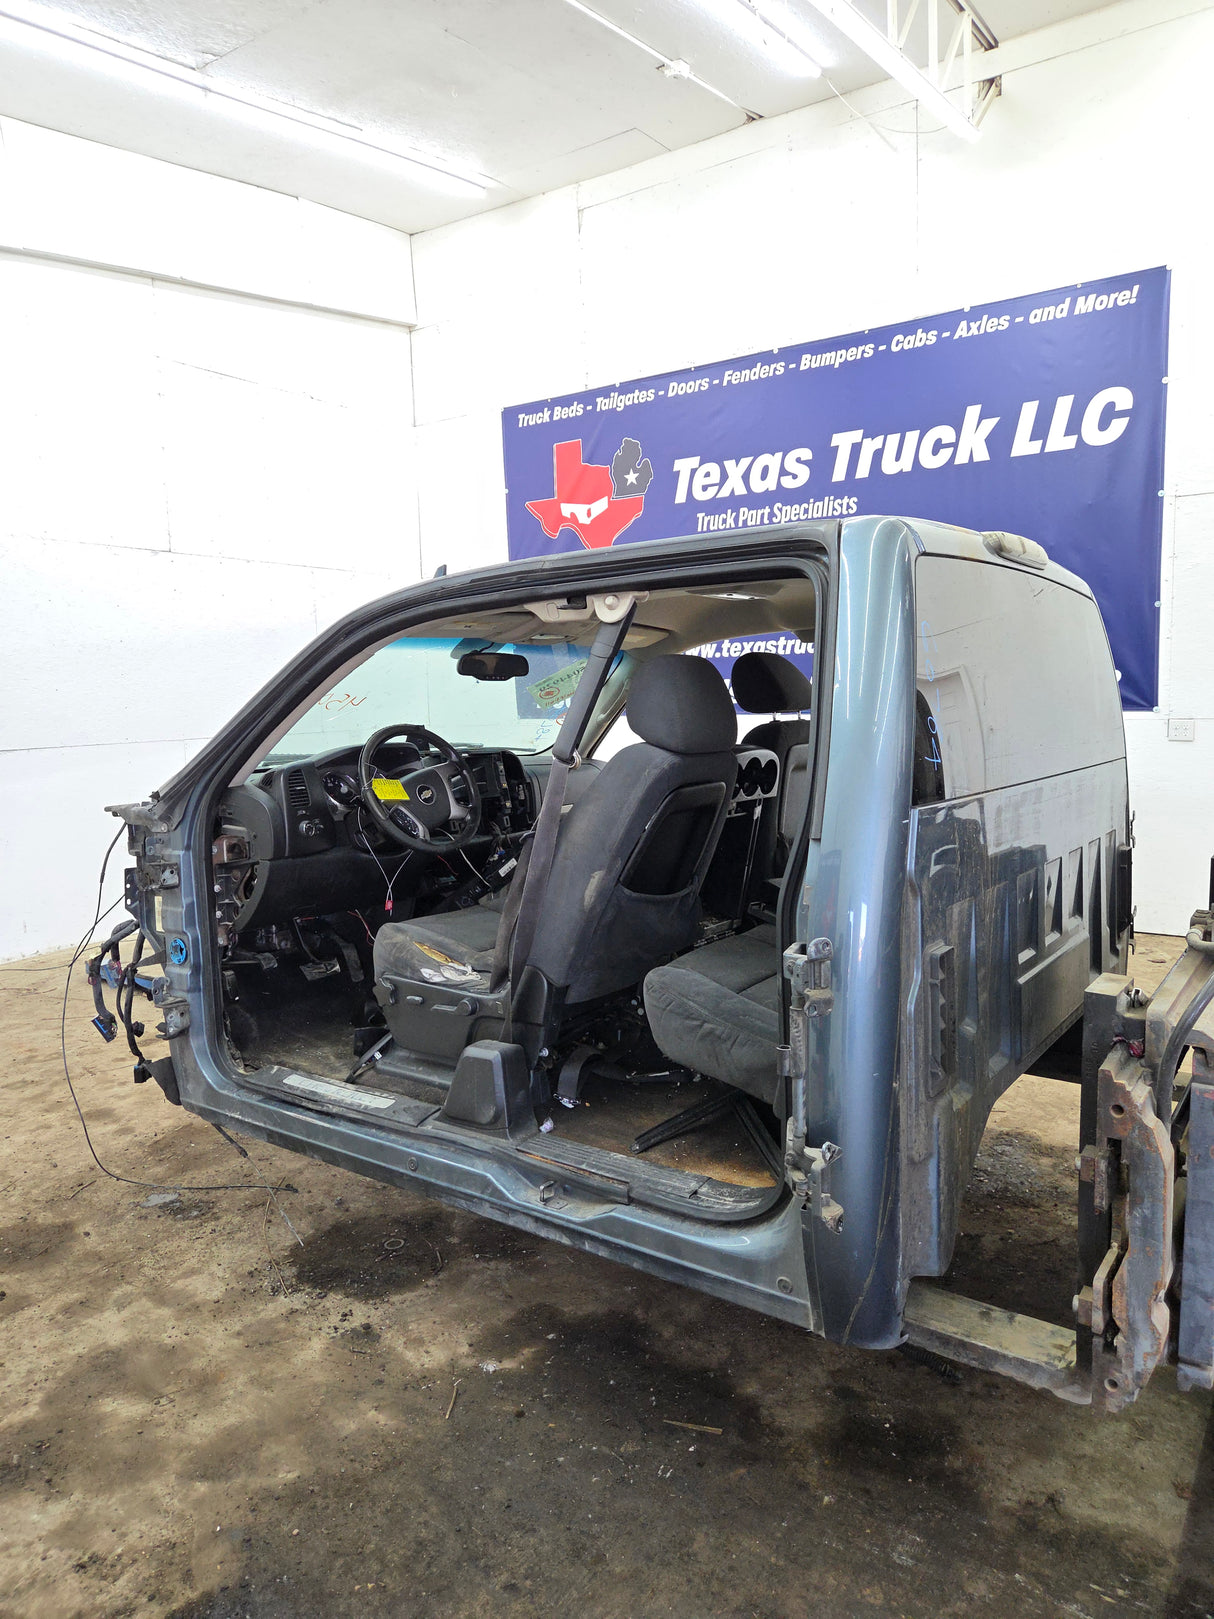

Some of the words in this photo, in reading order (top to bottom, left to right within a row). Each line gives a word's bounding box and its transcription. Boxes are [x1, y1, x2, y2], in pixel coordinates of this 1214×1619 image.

[517, 408, 552, 428] Truck
[552, 402, 585, 421] Beds
[595, 388, 655, 412] Tailgates
[667, 377, 710, 398] Doors
[722, 361, 785, 387] Fenders
[799, 343, 875, 372] Bumpers
[890, 328, 938, 353] Cabs
[952, 314, 1011, 340] Axles
[1028, 297, 1072, 325] and
[1073, 284, 1140, 316] More!
[672, 447, 813, 505] Texas
[830, 403, 1001, 483] Truck
[1010, 386, 1134, 458] LLC
[696, 509, 736, 533] Truck
[738, 504, 774, 528] Part
[775, 495, 858, 525] Specialists
